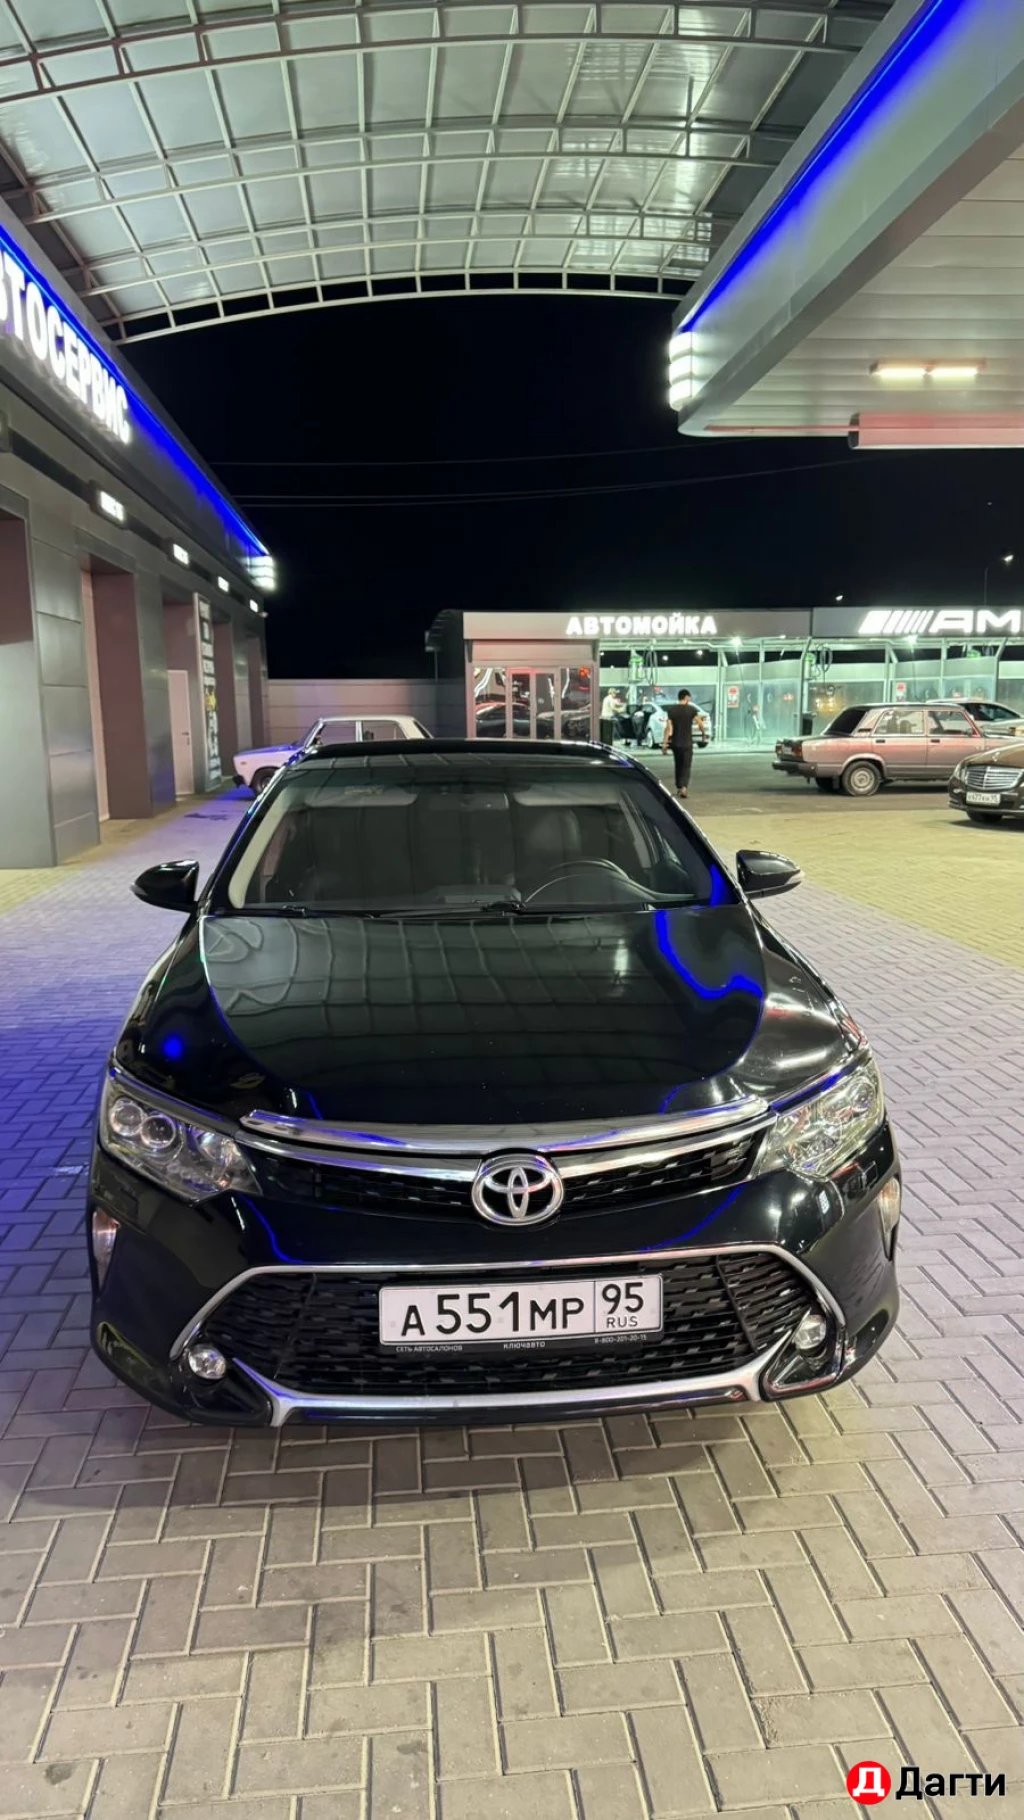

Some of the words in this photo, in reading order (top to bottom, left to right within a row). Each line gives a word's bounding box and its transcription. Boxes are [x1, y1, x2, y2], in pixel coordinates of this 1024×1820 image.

[0, 249, 131, 445] ТОСЕРВИС
[565, 612, 718, 636] АВТОМОЙКА
[401, 1291, 585, 1337] А551МР
[602, 1282, 644, 1315] 95
[606, 1316, 639, 1329] RUS
[413, 1345, 463, 1353] АВТОСАЛОНОВ
